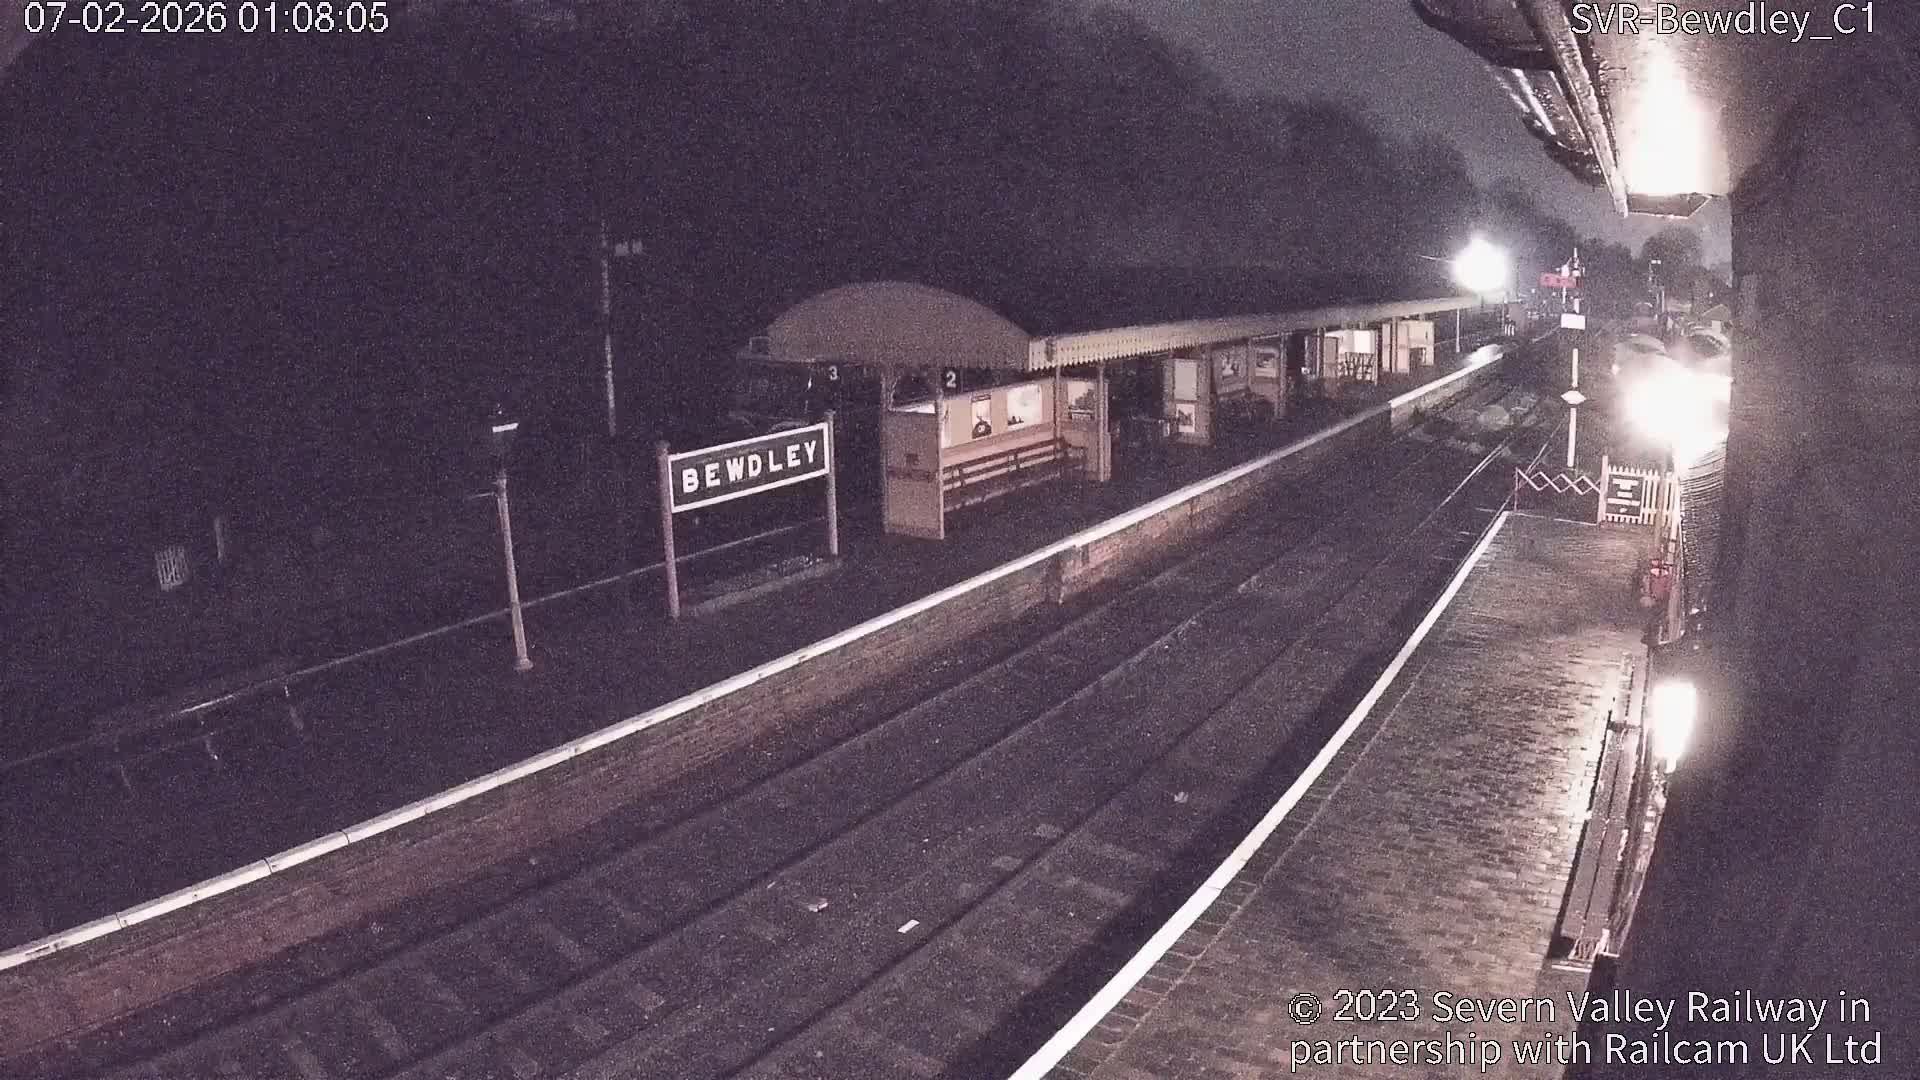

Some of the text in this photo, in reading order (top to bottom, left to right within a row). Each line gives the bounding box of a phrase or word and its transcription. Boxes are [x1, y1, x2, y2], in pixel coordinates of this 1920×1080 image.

[828, 365, 839, 381] 3
[946, 371, 957, 388] 2
[682, 439, 817, 494] BEWDLEY
